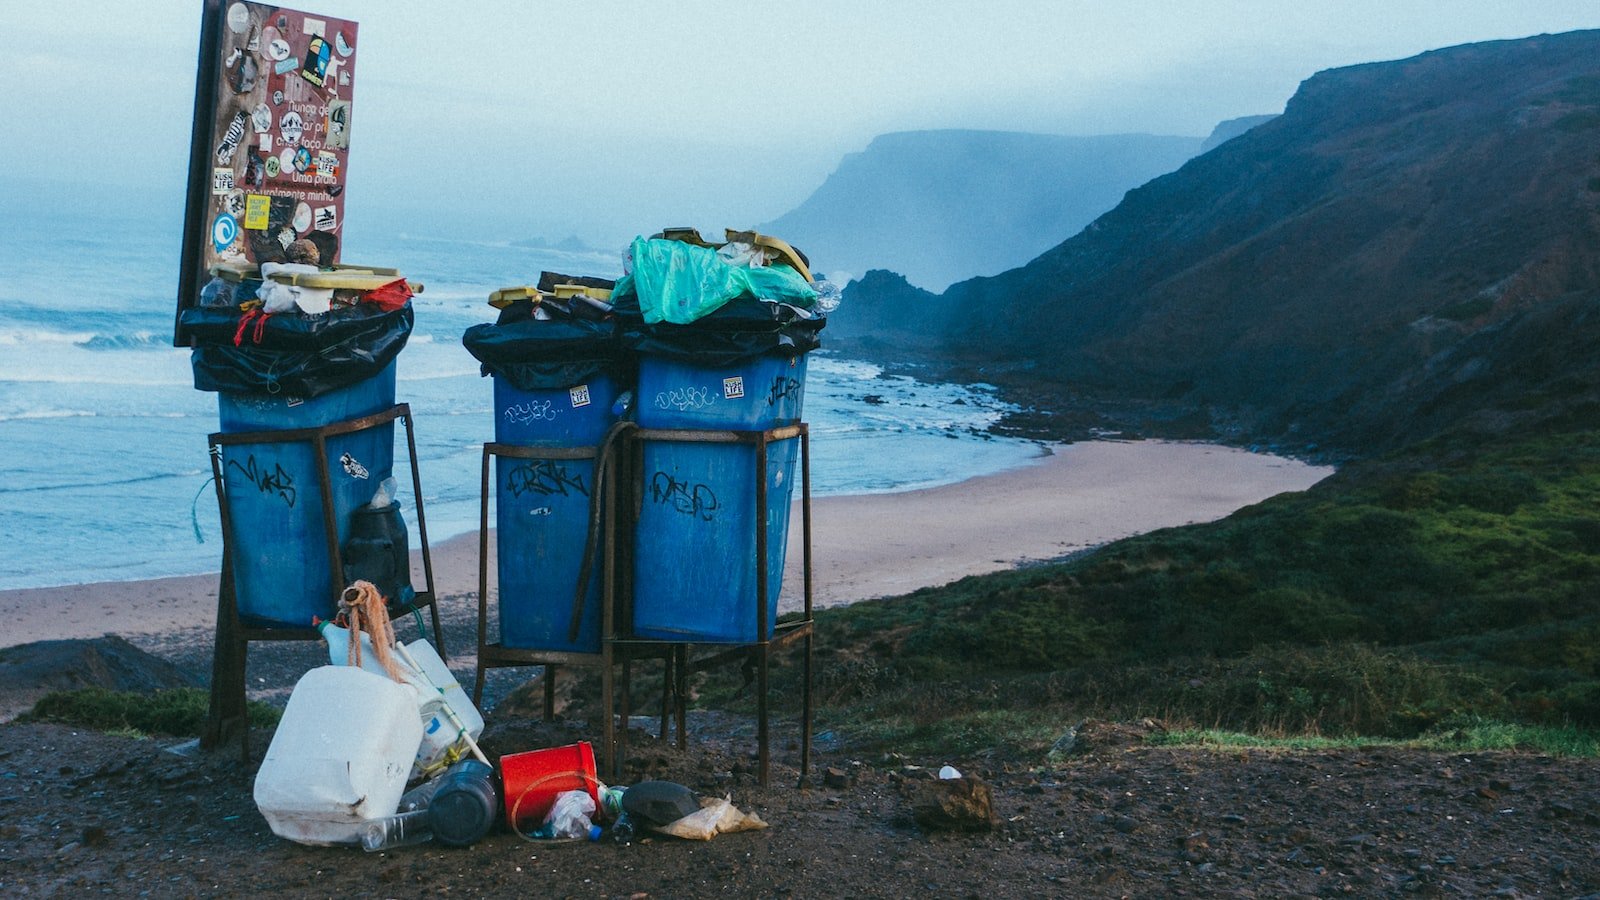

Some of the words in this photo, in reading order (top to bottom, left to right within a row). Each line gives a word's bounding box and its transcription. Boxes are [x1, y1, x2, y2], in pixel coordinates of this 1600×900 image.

[318, 162, 333, 173] LIFE
[292, 172, 313, 183] Uma
[314, 174, 337, 186] praia
[214, 180, 234, 189] LIFE
[725, 380, 742, 388] KUSH
[572, 389, 588, 398] KUSH
[725, 385, 743, 396] LIFE
[572, 394, 589, 404] LIFE
